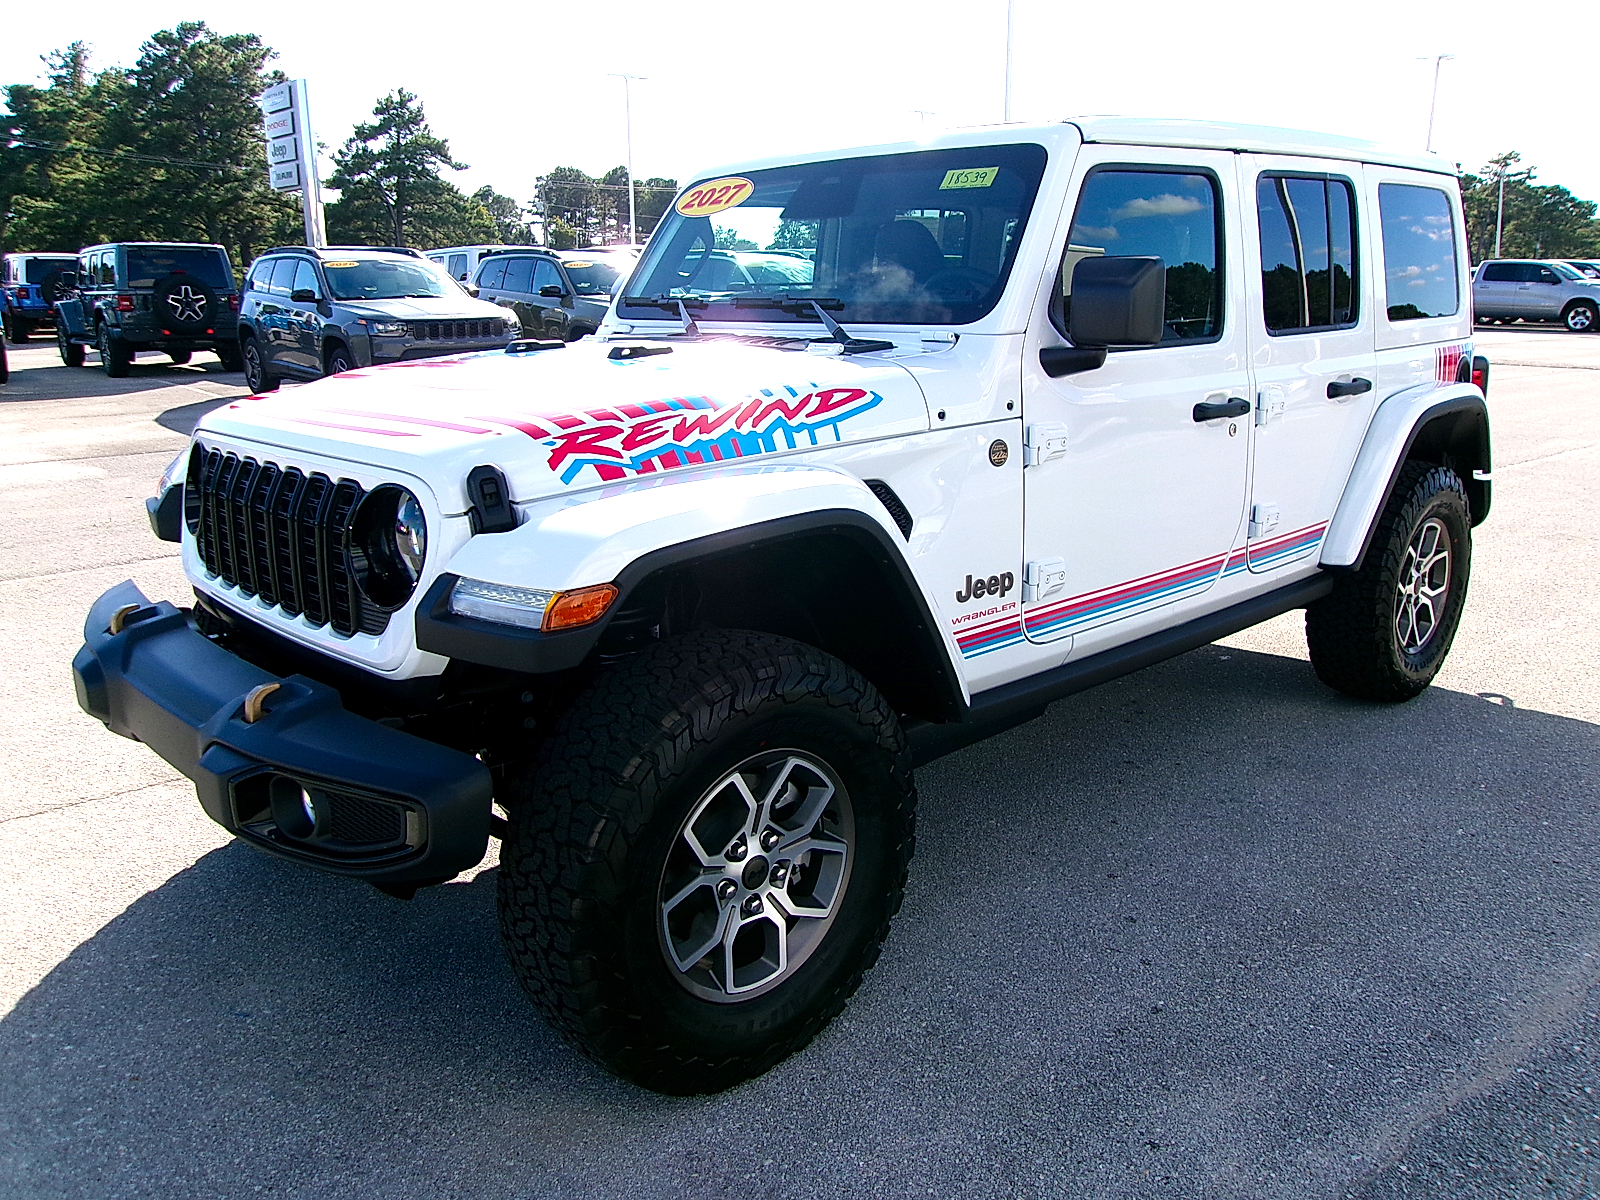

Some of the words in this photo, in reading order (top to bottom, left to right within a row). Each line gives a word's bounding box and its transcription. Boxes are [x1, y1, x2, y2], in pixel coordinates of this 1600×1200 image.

[266, 120, 288, 131] DODGE
[271, 143, 287, 159] Jeep
[948, 171, 988, 185] 18539
[681, 183, 749, 210] 2027
[546, 388, 868, 472] REWIND
[956, 571, 1014, 603] Jeep
[951, 602, 1017, 625] WRANGLER
